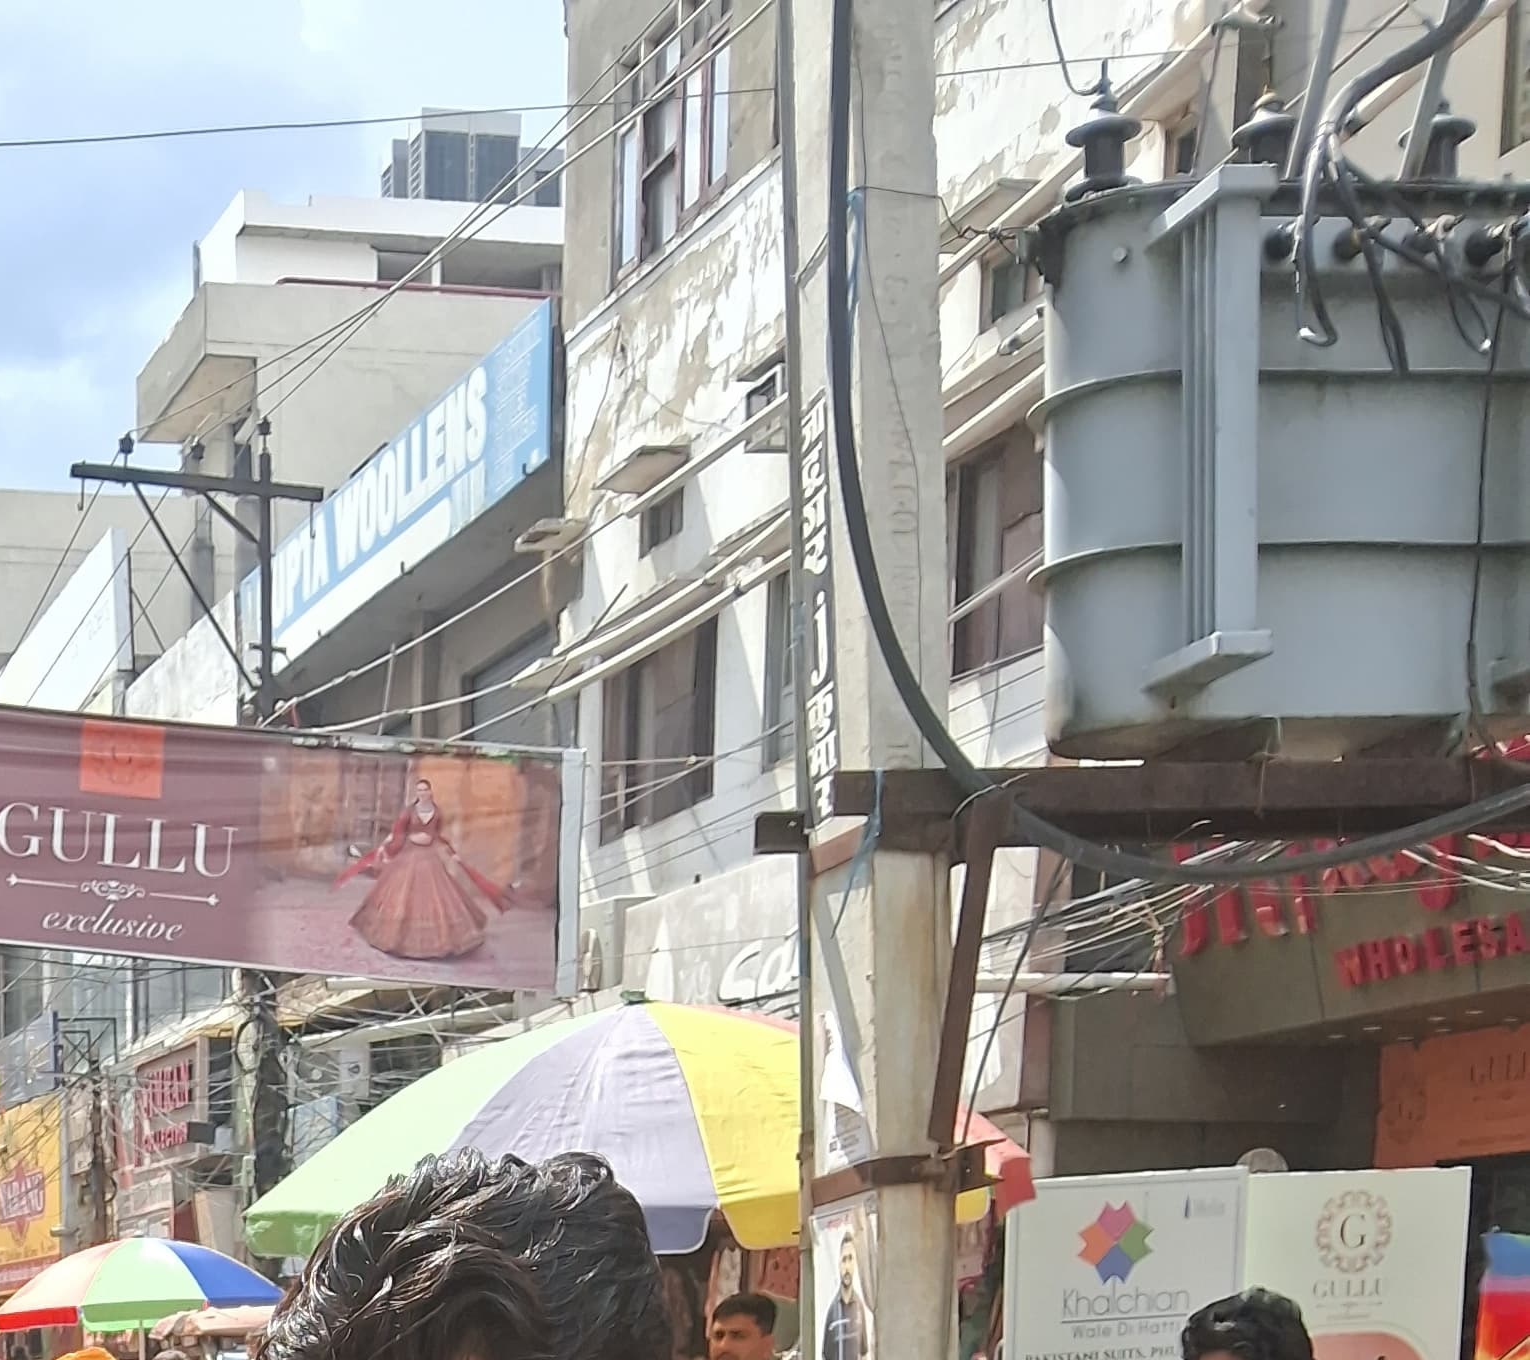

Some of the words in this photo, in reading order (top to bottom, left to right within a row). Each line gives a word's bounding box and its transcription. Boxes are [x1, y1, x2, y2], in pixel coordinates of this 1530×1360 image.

[265, 510, 330, 632] UPTA
[333, 366, 487, 572] WOOLLENS
[41, 903, 183, 941] exclusive
[1073, 1321, 1112, 1340] Wale
